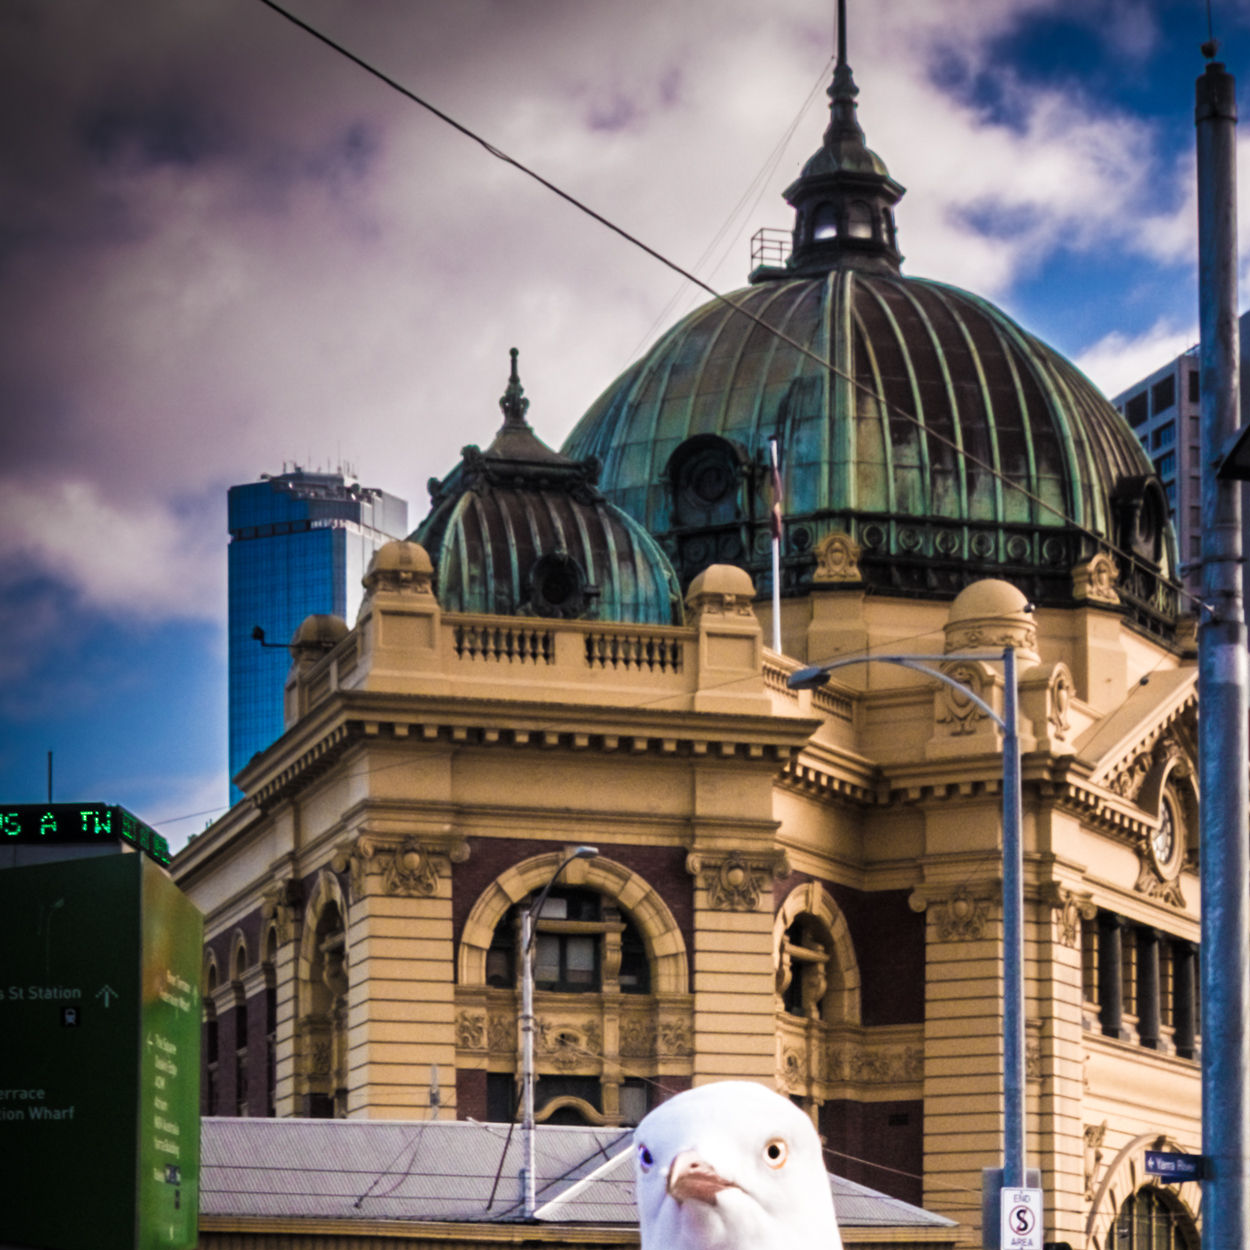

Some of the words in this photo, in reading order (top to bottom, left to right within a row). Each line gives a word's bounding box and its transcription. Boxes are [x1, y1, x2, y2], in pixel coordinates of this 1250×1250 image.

[8, 986, 24, 1000] St
[28, 985, 82, 1000] Station
[28, 1105, 75, 1121] Wharf
[1013, 1194, 1031, 1203] END
[1011, 1237, 1033, 1246] AREA
